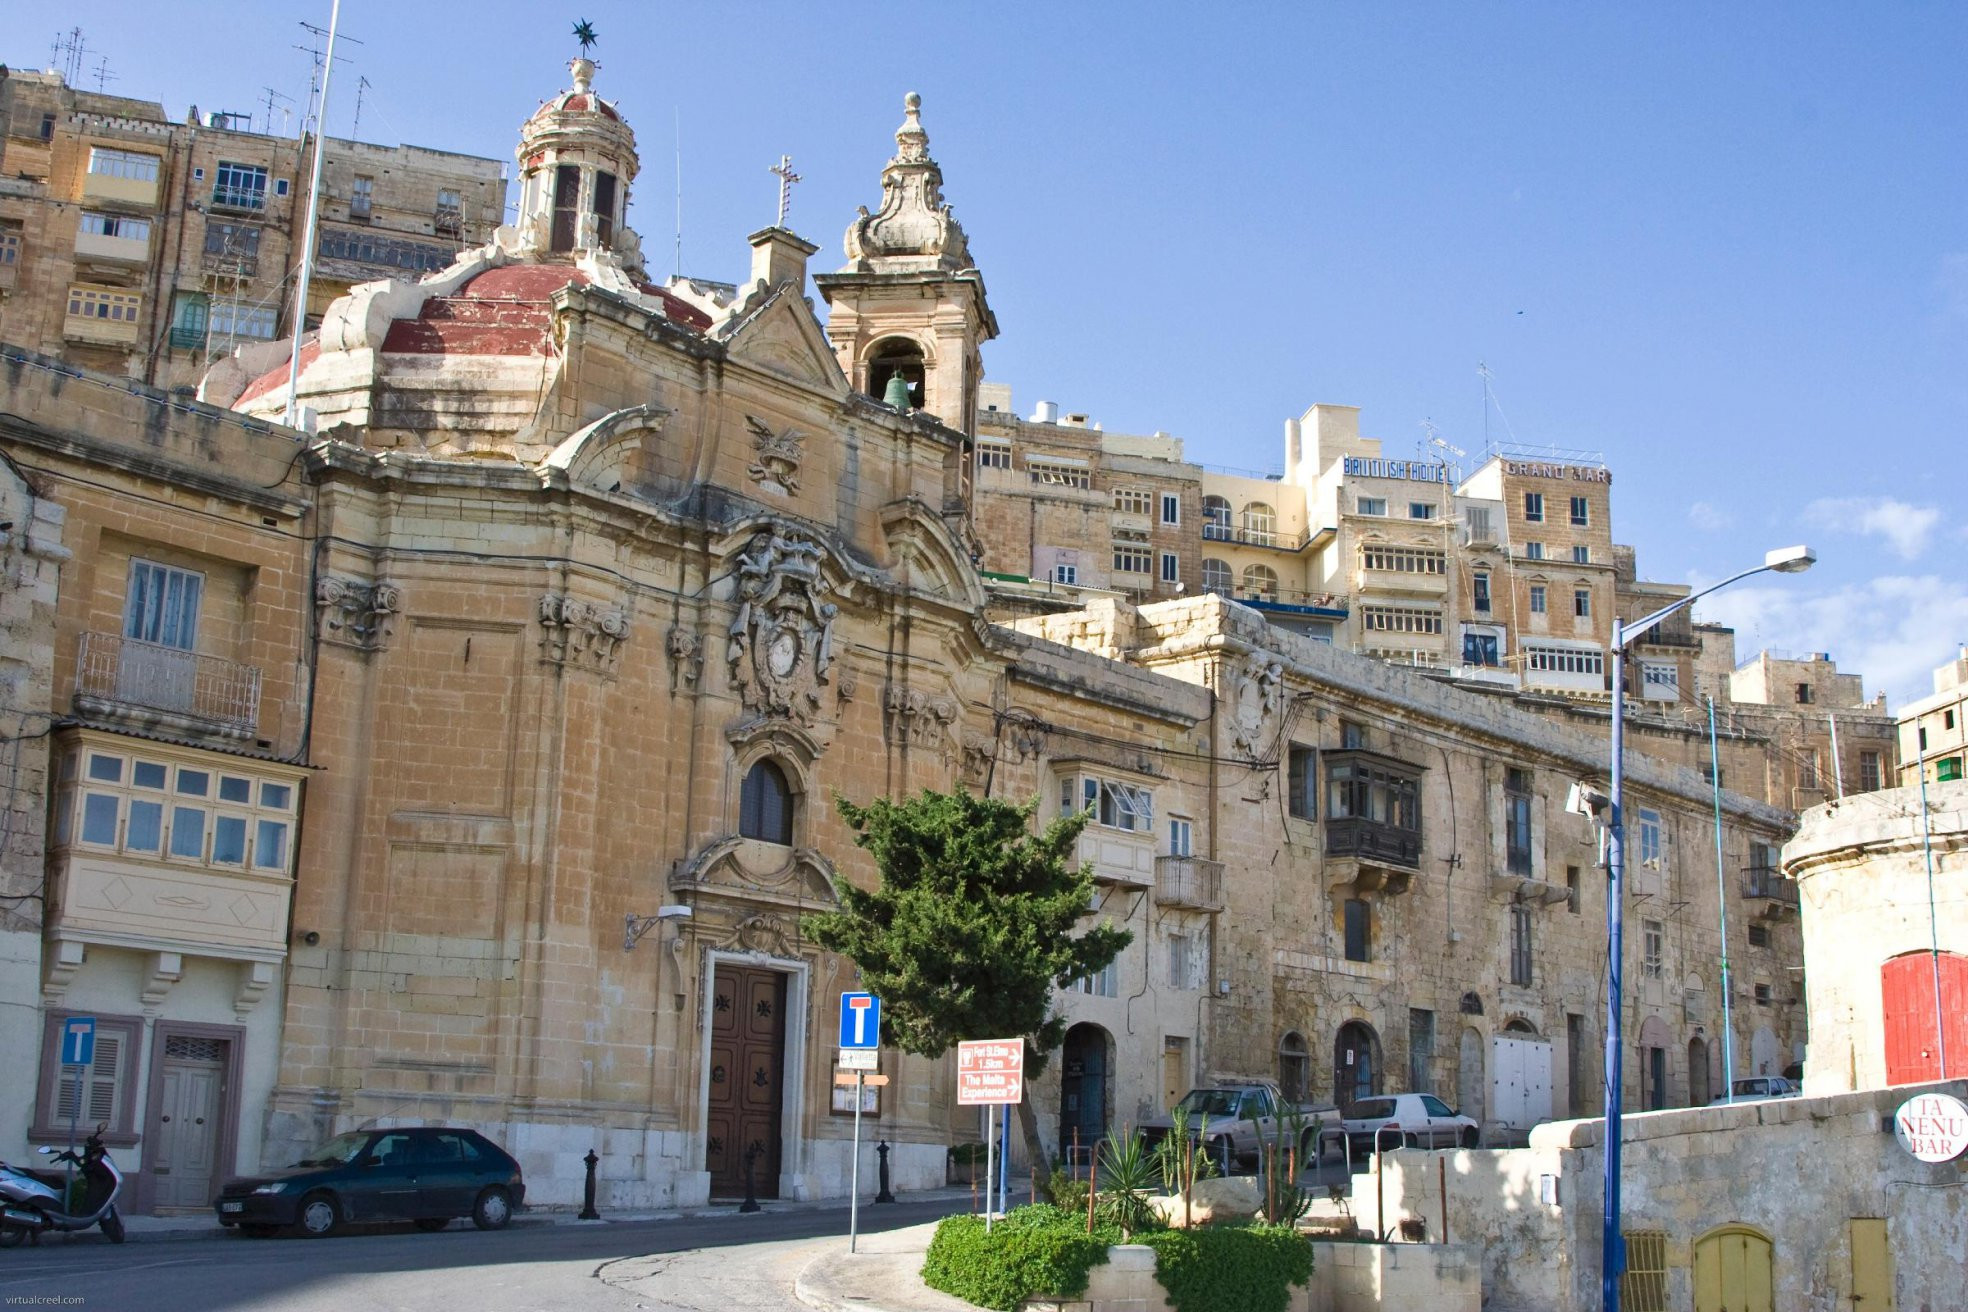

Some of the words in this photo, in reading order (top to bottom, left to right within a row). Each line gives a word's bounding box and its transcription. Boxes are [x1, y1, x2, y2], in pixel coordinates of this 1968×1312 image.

[1343, 458, 1406, 479] BRITISH
[1411, 463, 1454, 483] HOTEL
[1505, 462, 1565, 479] GRAND
[973, 1046, 985, 1057] Fort
[978, 1059, 1004, 1069] 1.5km
[965, 1074, 981, 1086] The
[982, 1073, 1006, 1085] Malta
[961, 1086, 1008, 1101] Experience
[1900, 1117, 1964, 1137] NENU
[1911, 1138, 1952, 1155] BAR
